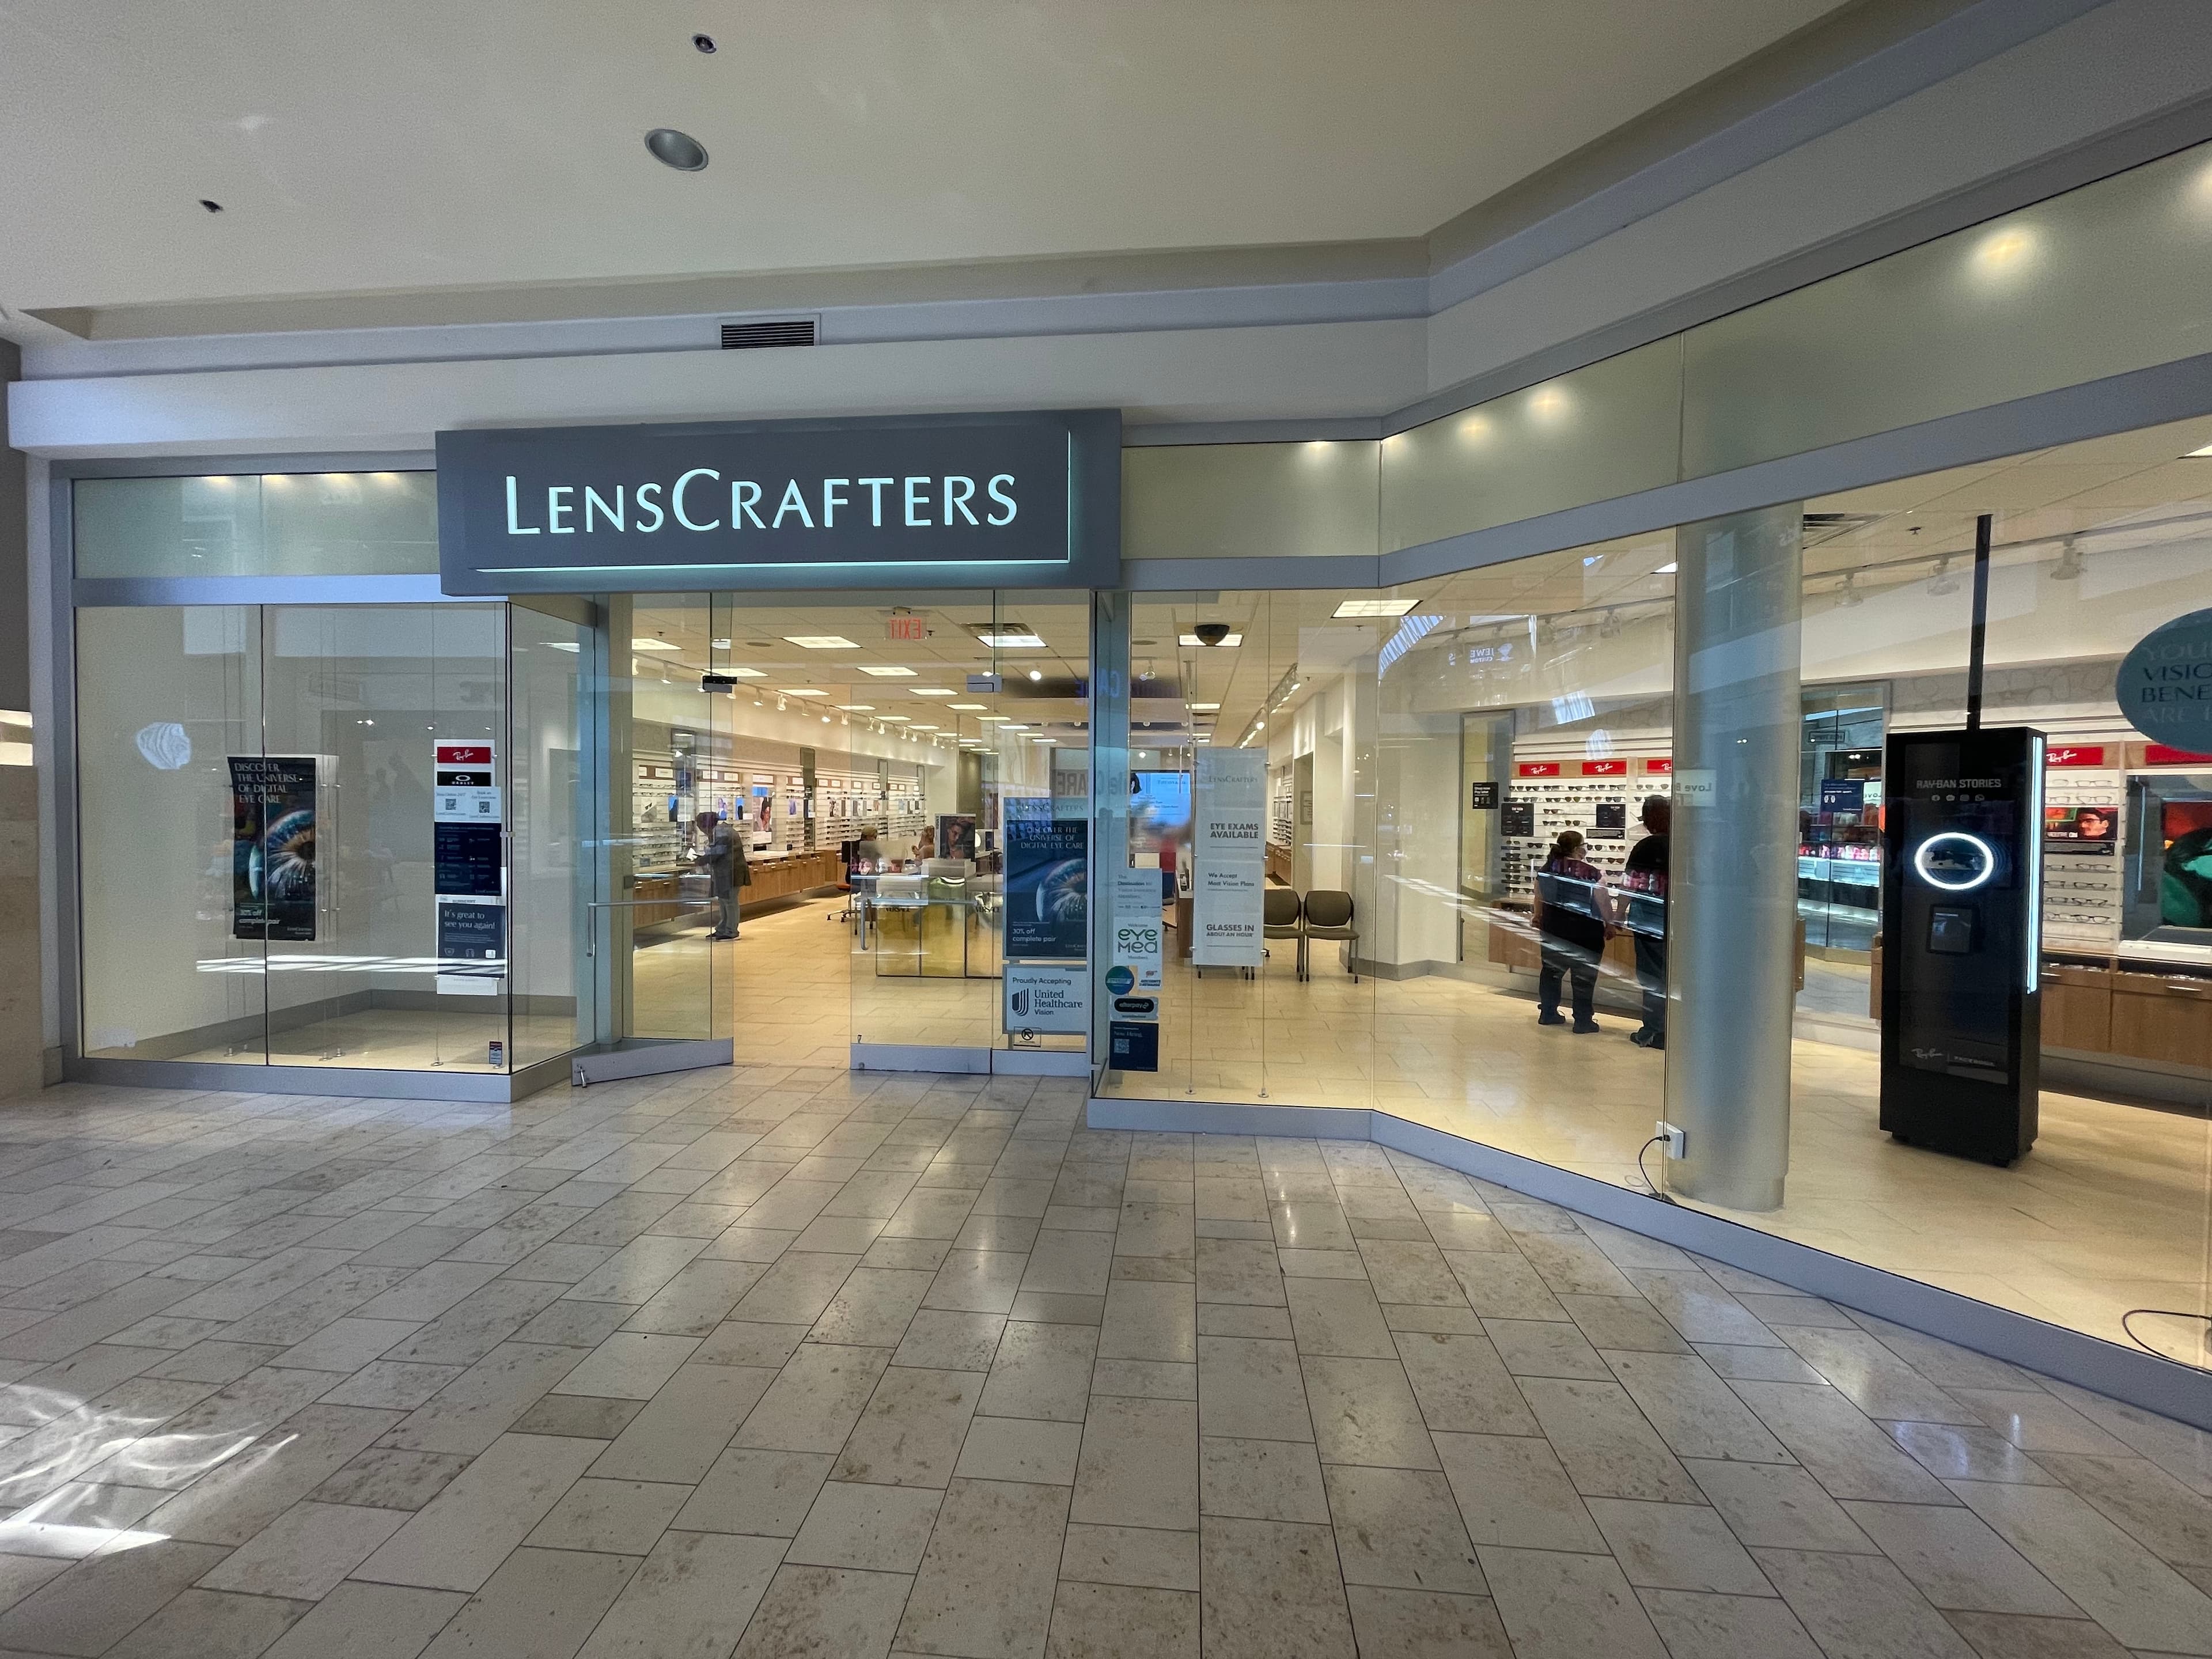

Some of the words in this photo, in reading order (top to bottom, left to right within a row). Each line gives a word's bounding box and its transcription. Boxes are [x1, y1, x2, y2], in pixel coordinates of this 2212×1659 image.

[237, 774, 255, 782] THE
[1959, 779, 2002, 788] STORIES
[238, 785, 252, 793] OF
[253, 785, 287, 793] DIGITAL
[239, 795, 256, 804] EYE
[257, 795, 282, 804] CARE
[445, 910, 456, 918] It's
[457, 911, 475, 919] great
[474, 922, 495, 931] again!
[1118, 929, 1158, 941] eye
[1035, 990, 1064, 998] United
[1035, 999, 1083, 1008] Healthcare
